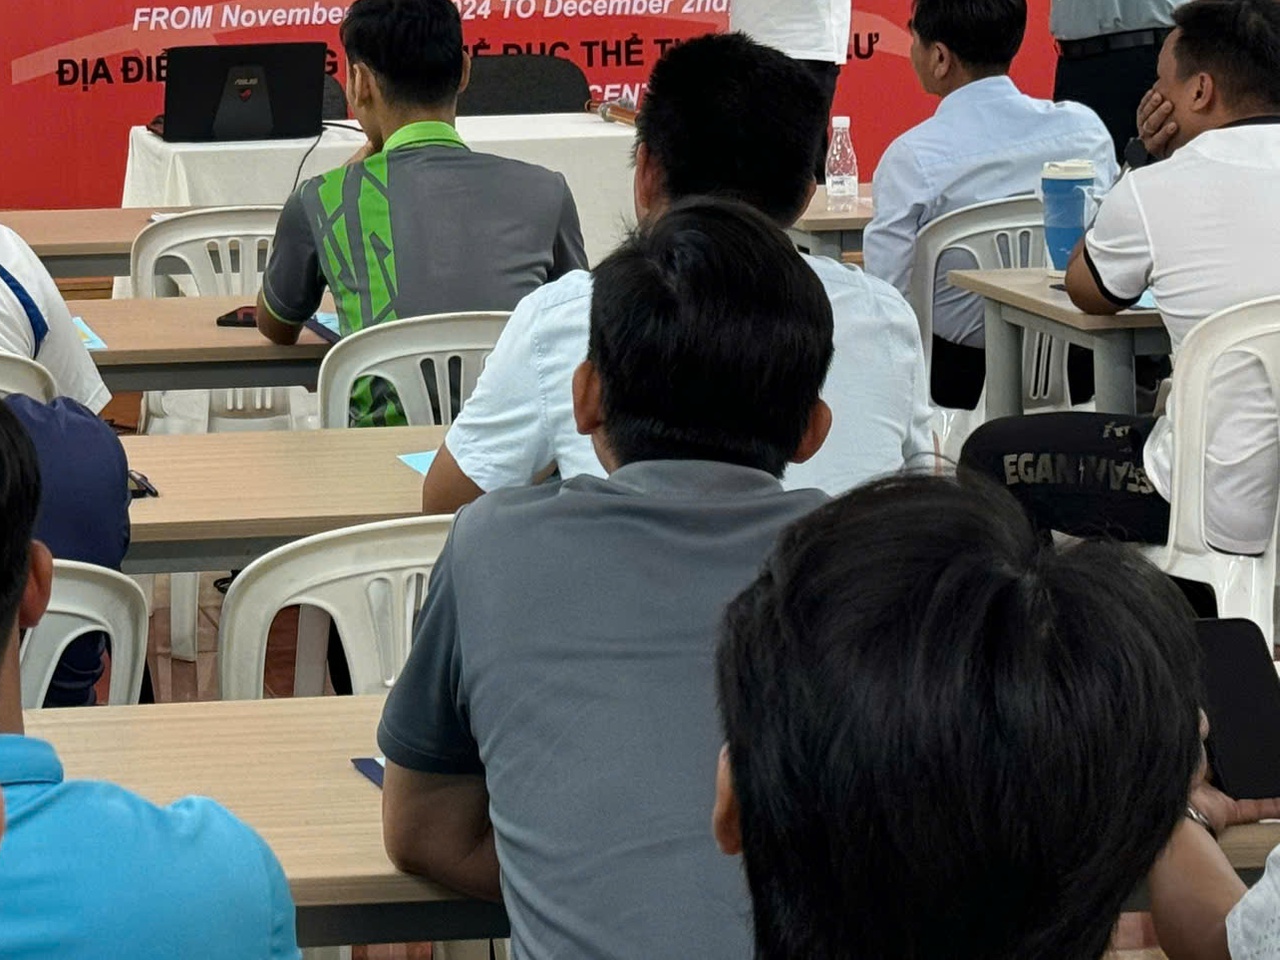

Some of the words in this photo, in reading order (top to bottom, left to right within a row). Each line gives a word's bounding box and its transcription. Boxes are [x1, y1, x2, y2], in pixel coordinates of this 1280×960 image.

[131, 5, 213, 32] FROM
[56, 58, 115, 92] ĐỊA
[580, 32, 645, 68] THỂ
[846, 32, 880, 60] Ư
